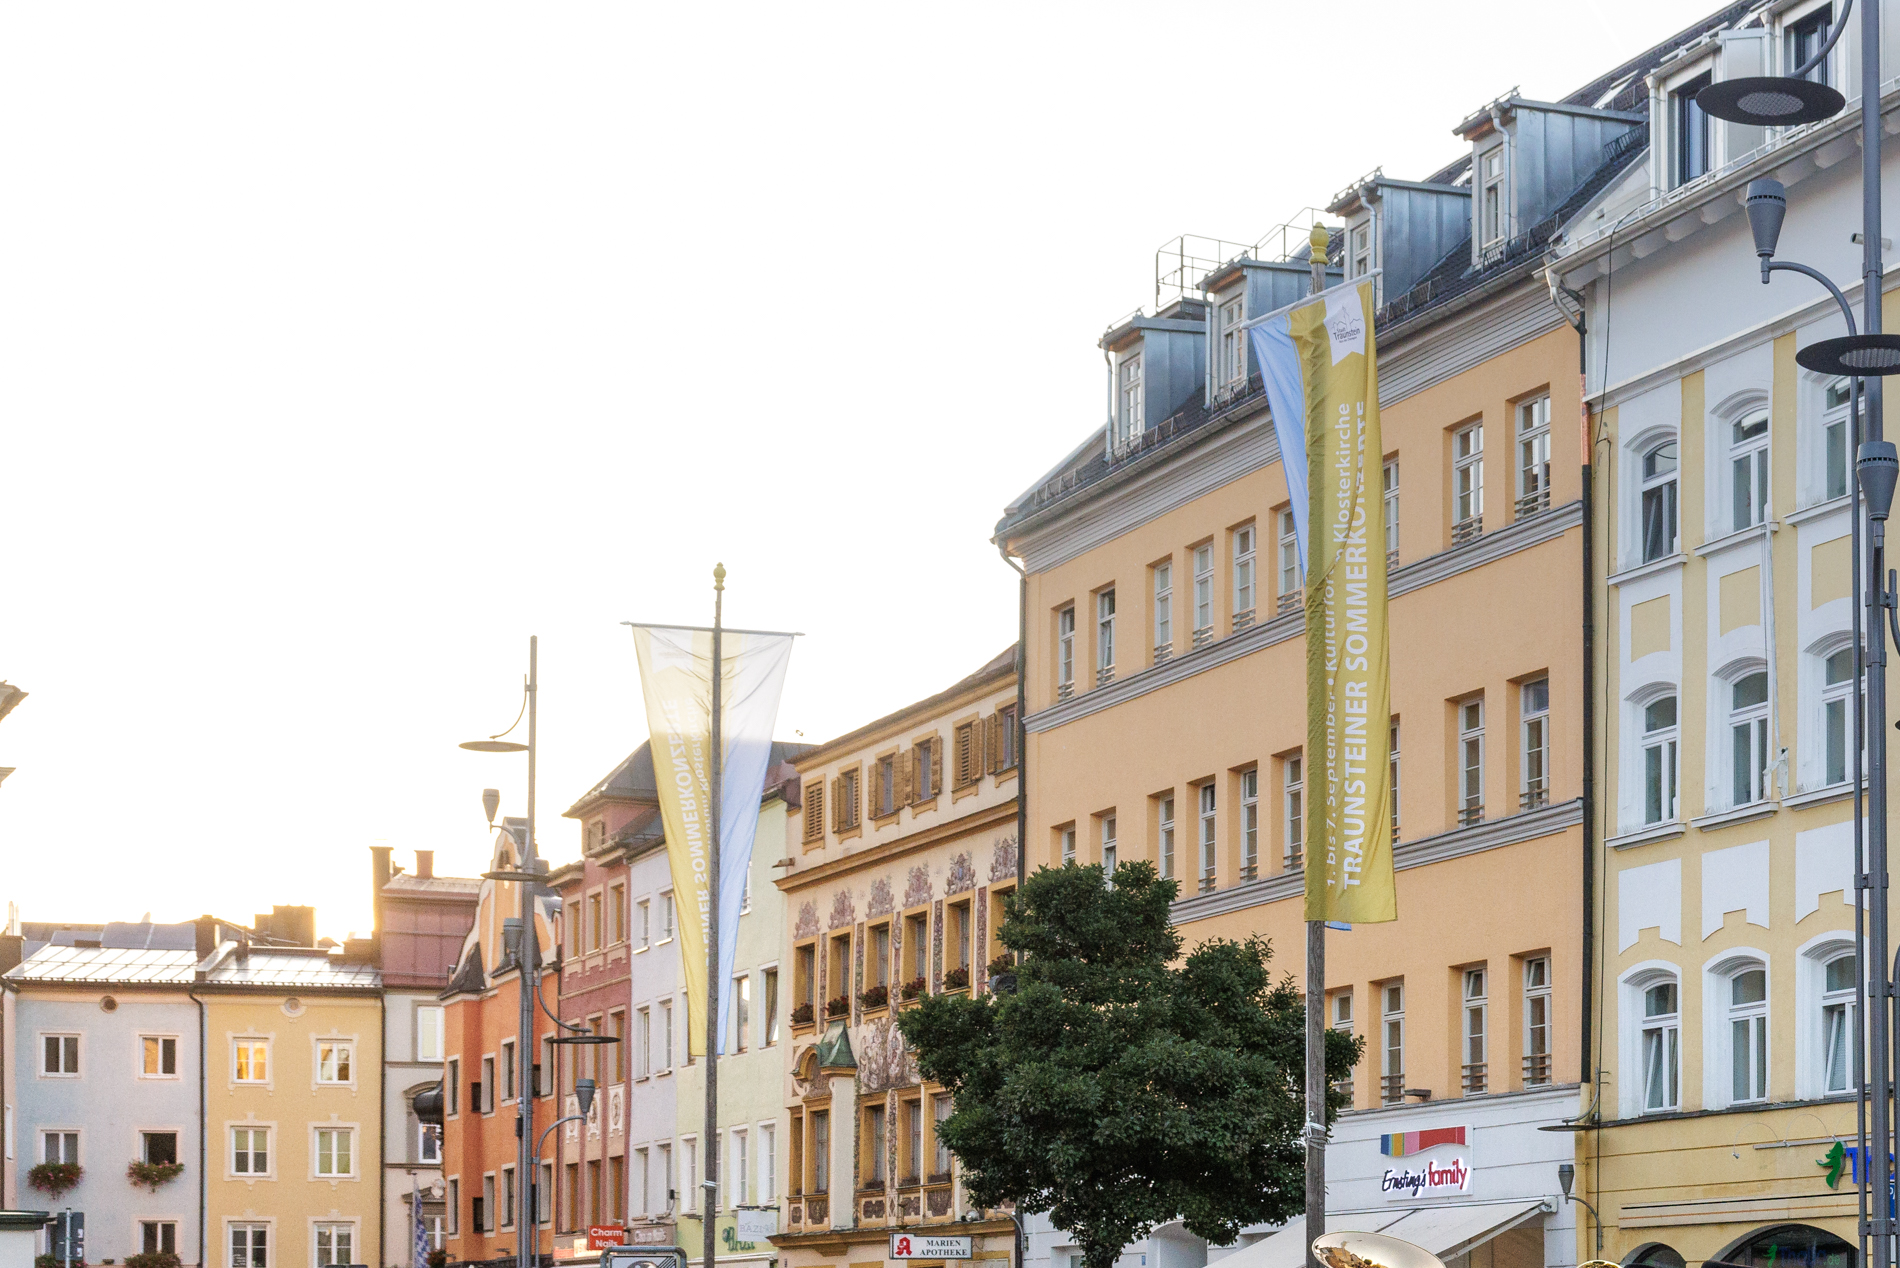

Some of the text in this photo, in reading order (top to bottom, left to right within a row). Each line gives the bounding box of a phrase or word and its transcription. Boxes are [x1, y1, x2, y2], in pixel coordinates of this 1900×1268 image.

[1333, 403, 1351, 542] Klosterkirche
[1326, 694, 1339, 805] September
[1343, 681, 1368, 890] TRAUNSTEINER
[1326, 837, 1336, 865] bis
[1382, 1158, 1467, 1197] Ernsting's family
[591, 1228, 623, 1237] Charm
[595, 1239, 618, 1248] Nails
